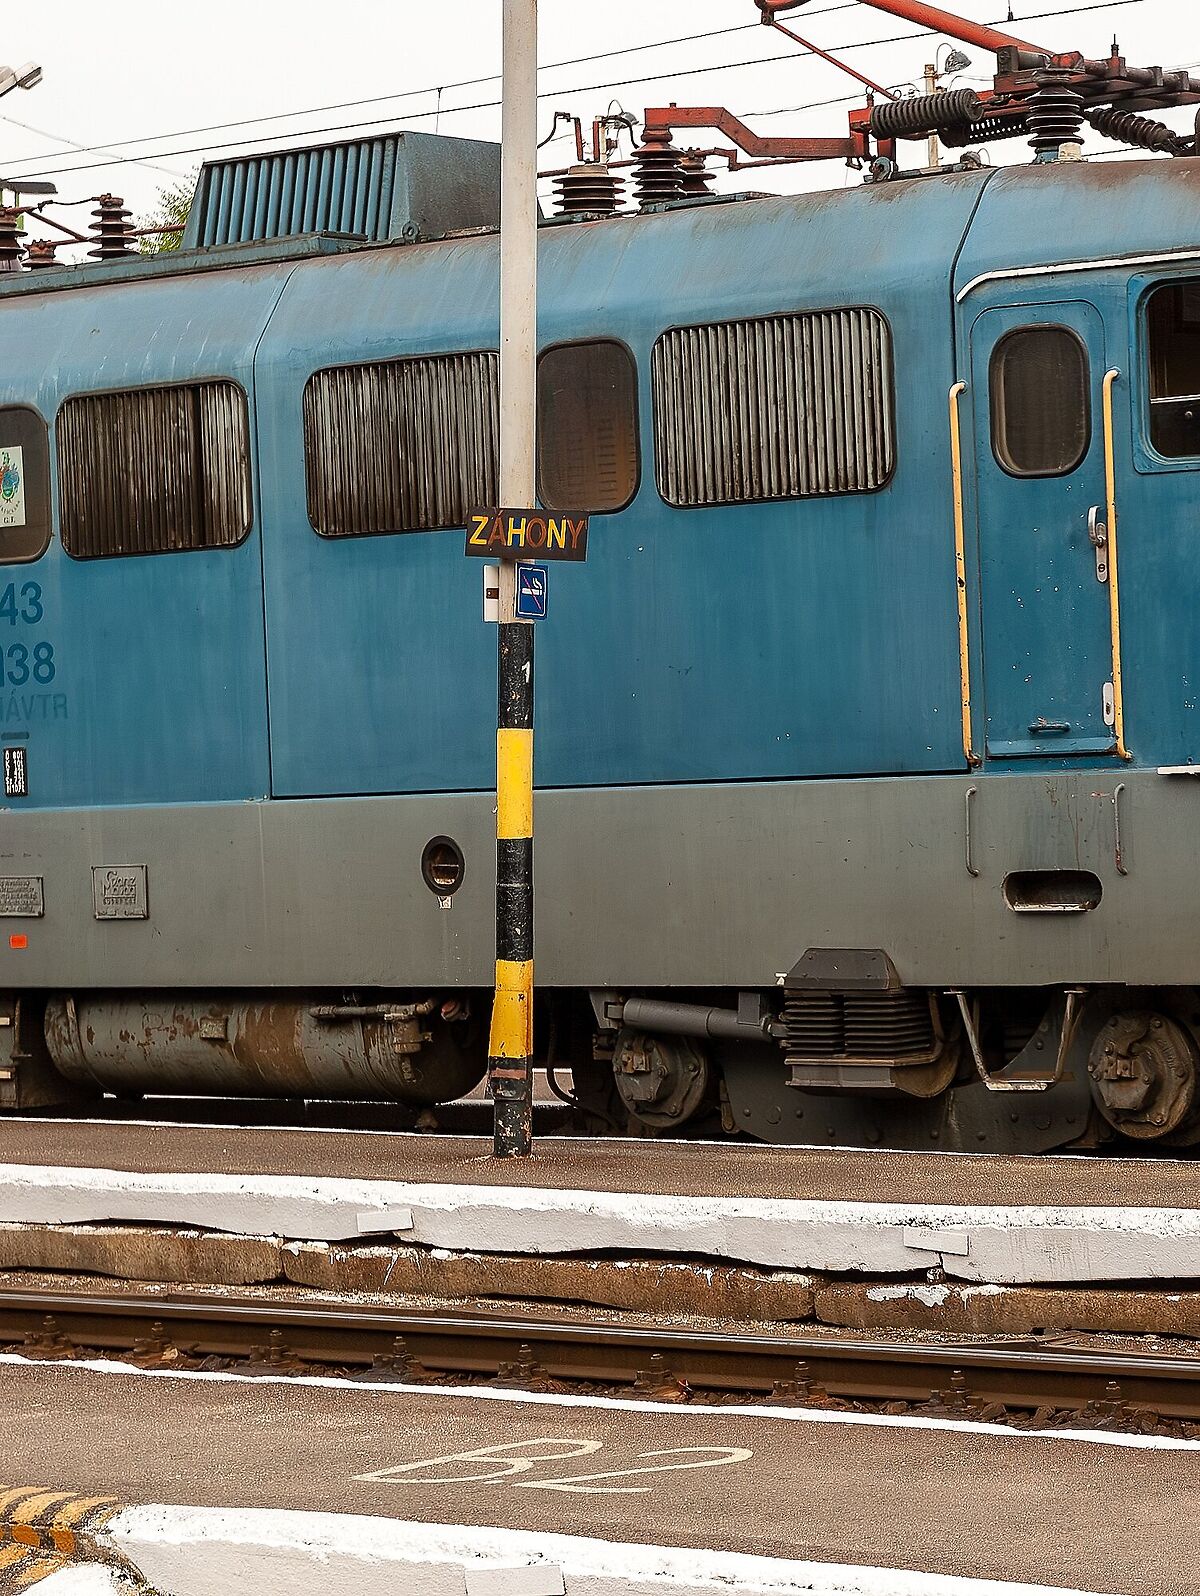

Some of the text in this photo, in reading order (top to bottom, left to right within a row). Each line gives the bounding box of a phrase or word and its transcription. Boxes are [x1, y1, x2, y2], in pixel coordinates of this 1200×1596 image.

[469, 510, 584, 549] ZÁHONY
[0, 581, 43, 625] 43
[0, 689, 68, 722] ÁVTR
